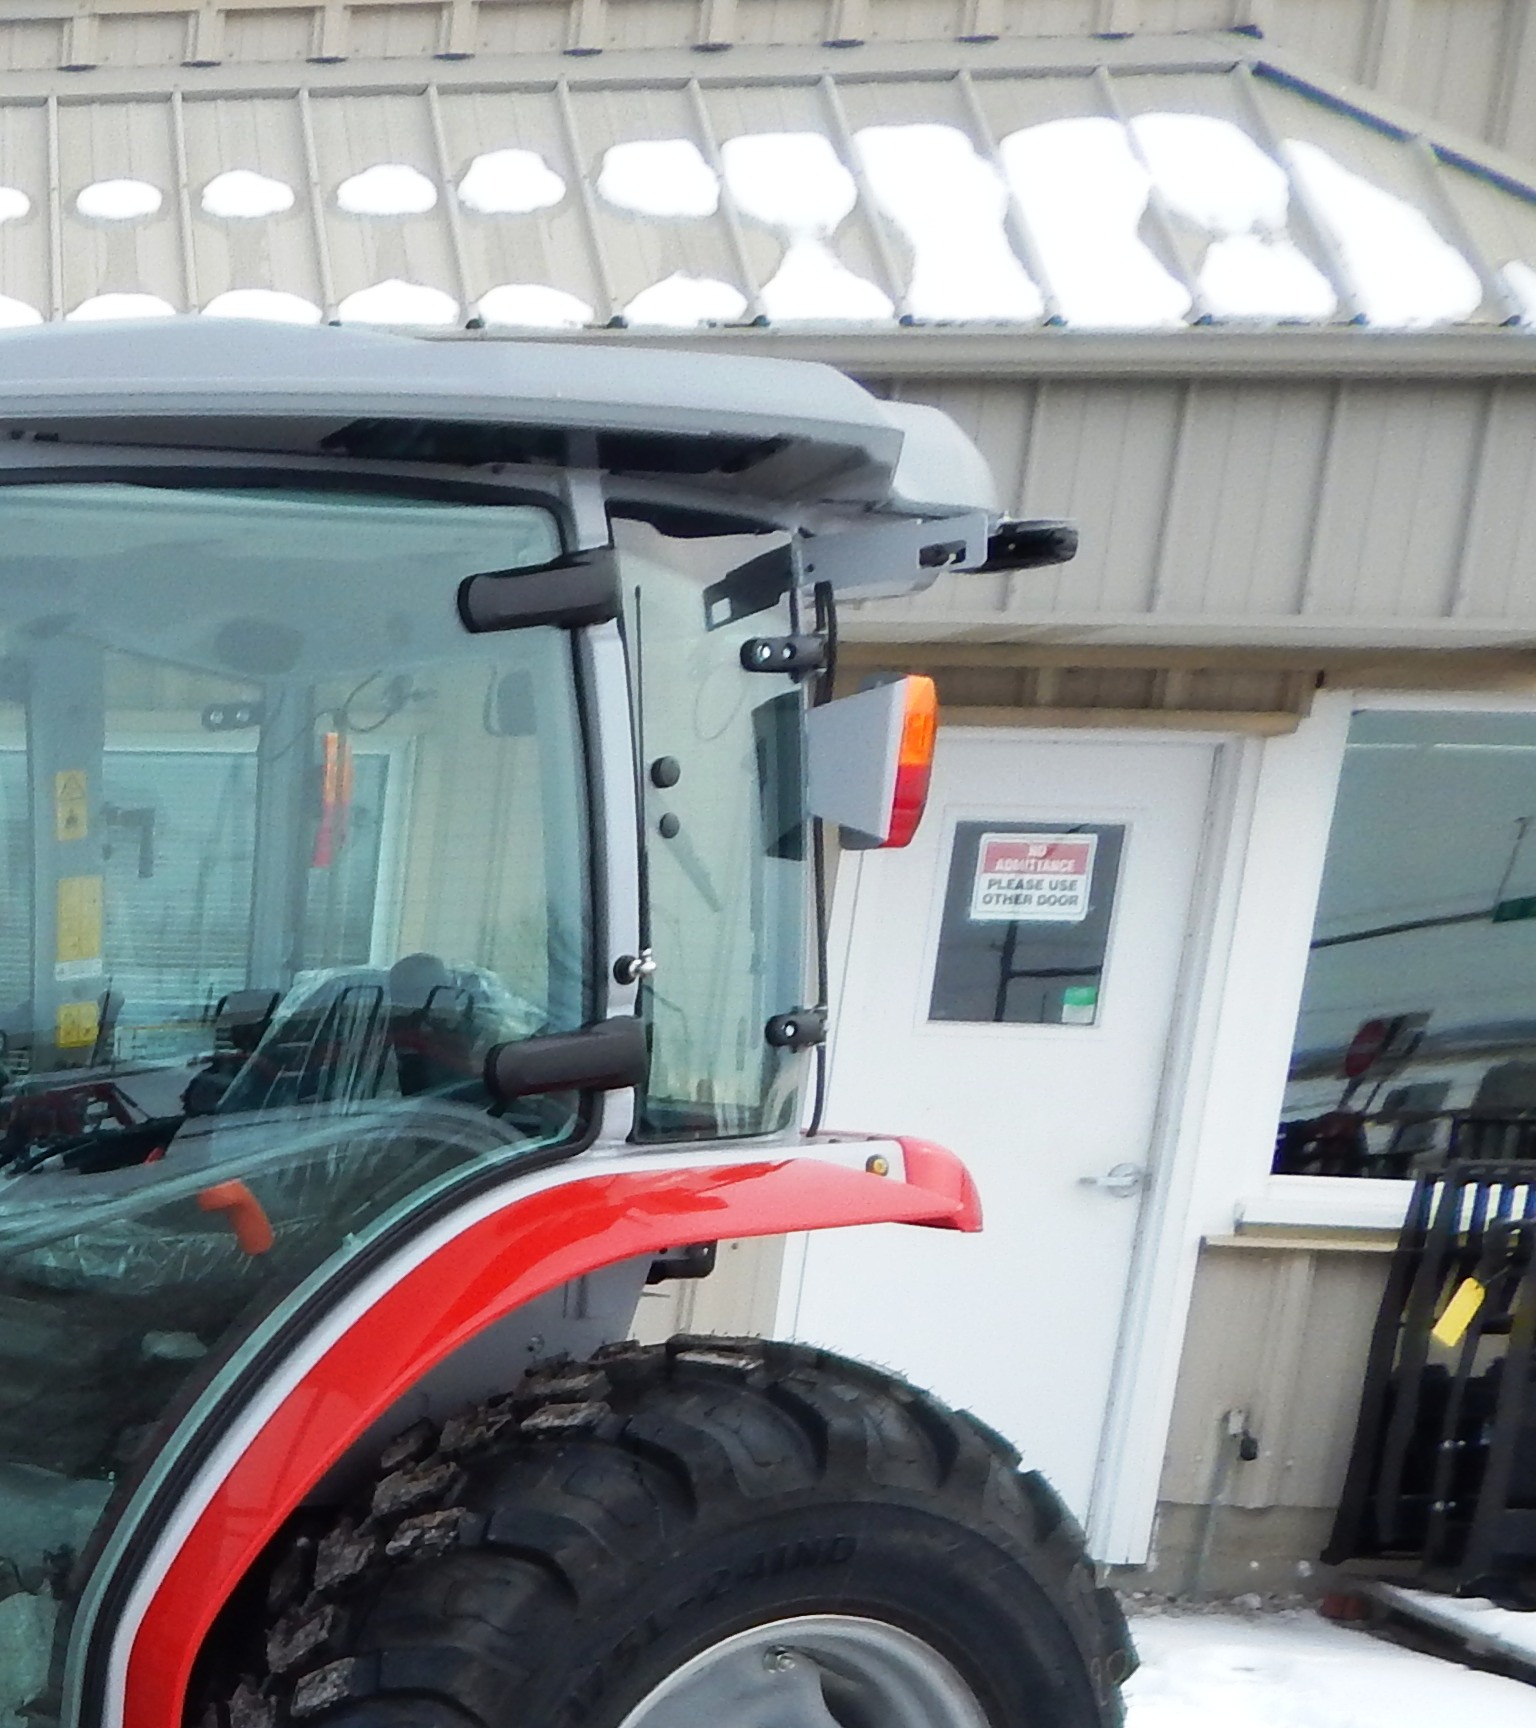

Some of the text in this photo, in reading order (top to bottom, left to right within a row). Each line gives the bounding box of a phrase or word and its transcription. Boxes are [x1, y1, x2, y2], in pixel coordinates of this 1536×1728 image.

[987, 878, 1078, 891] PLEASE USE
[982, 893, 1079, 906] OTHER DOOR
